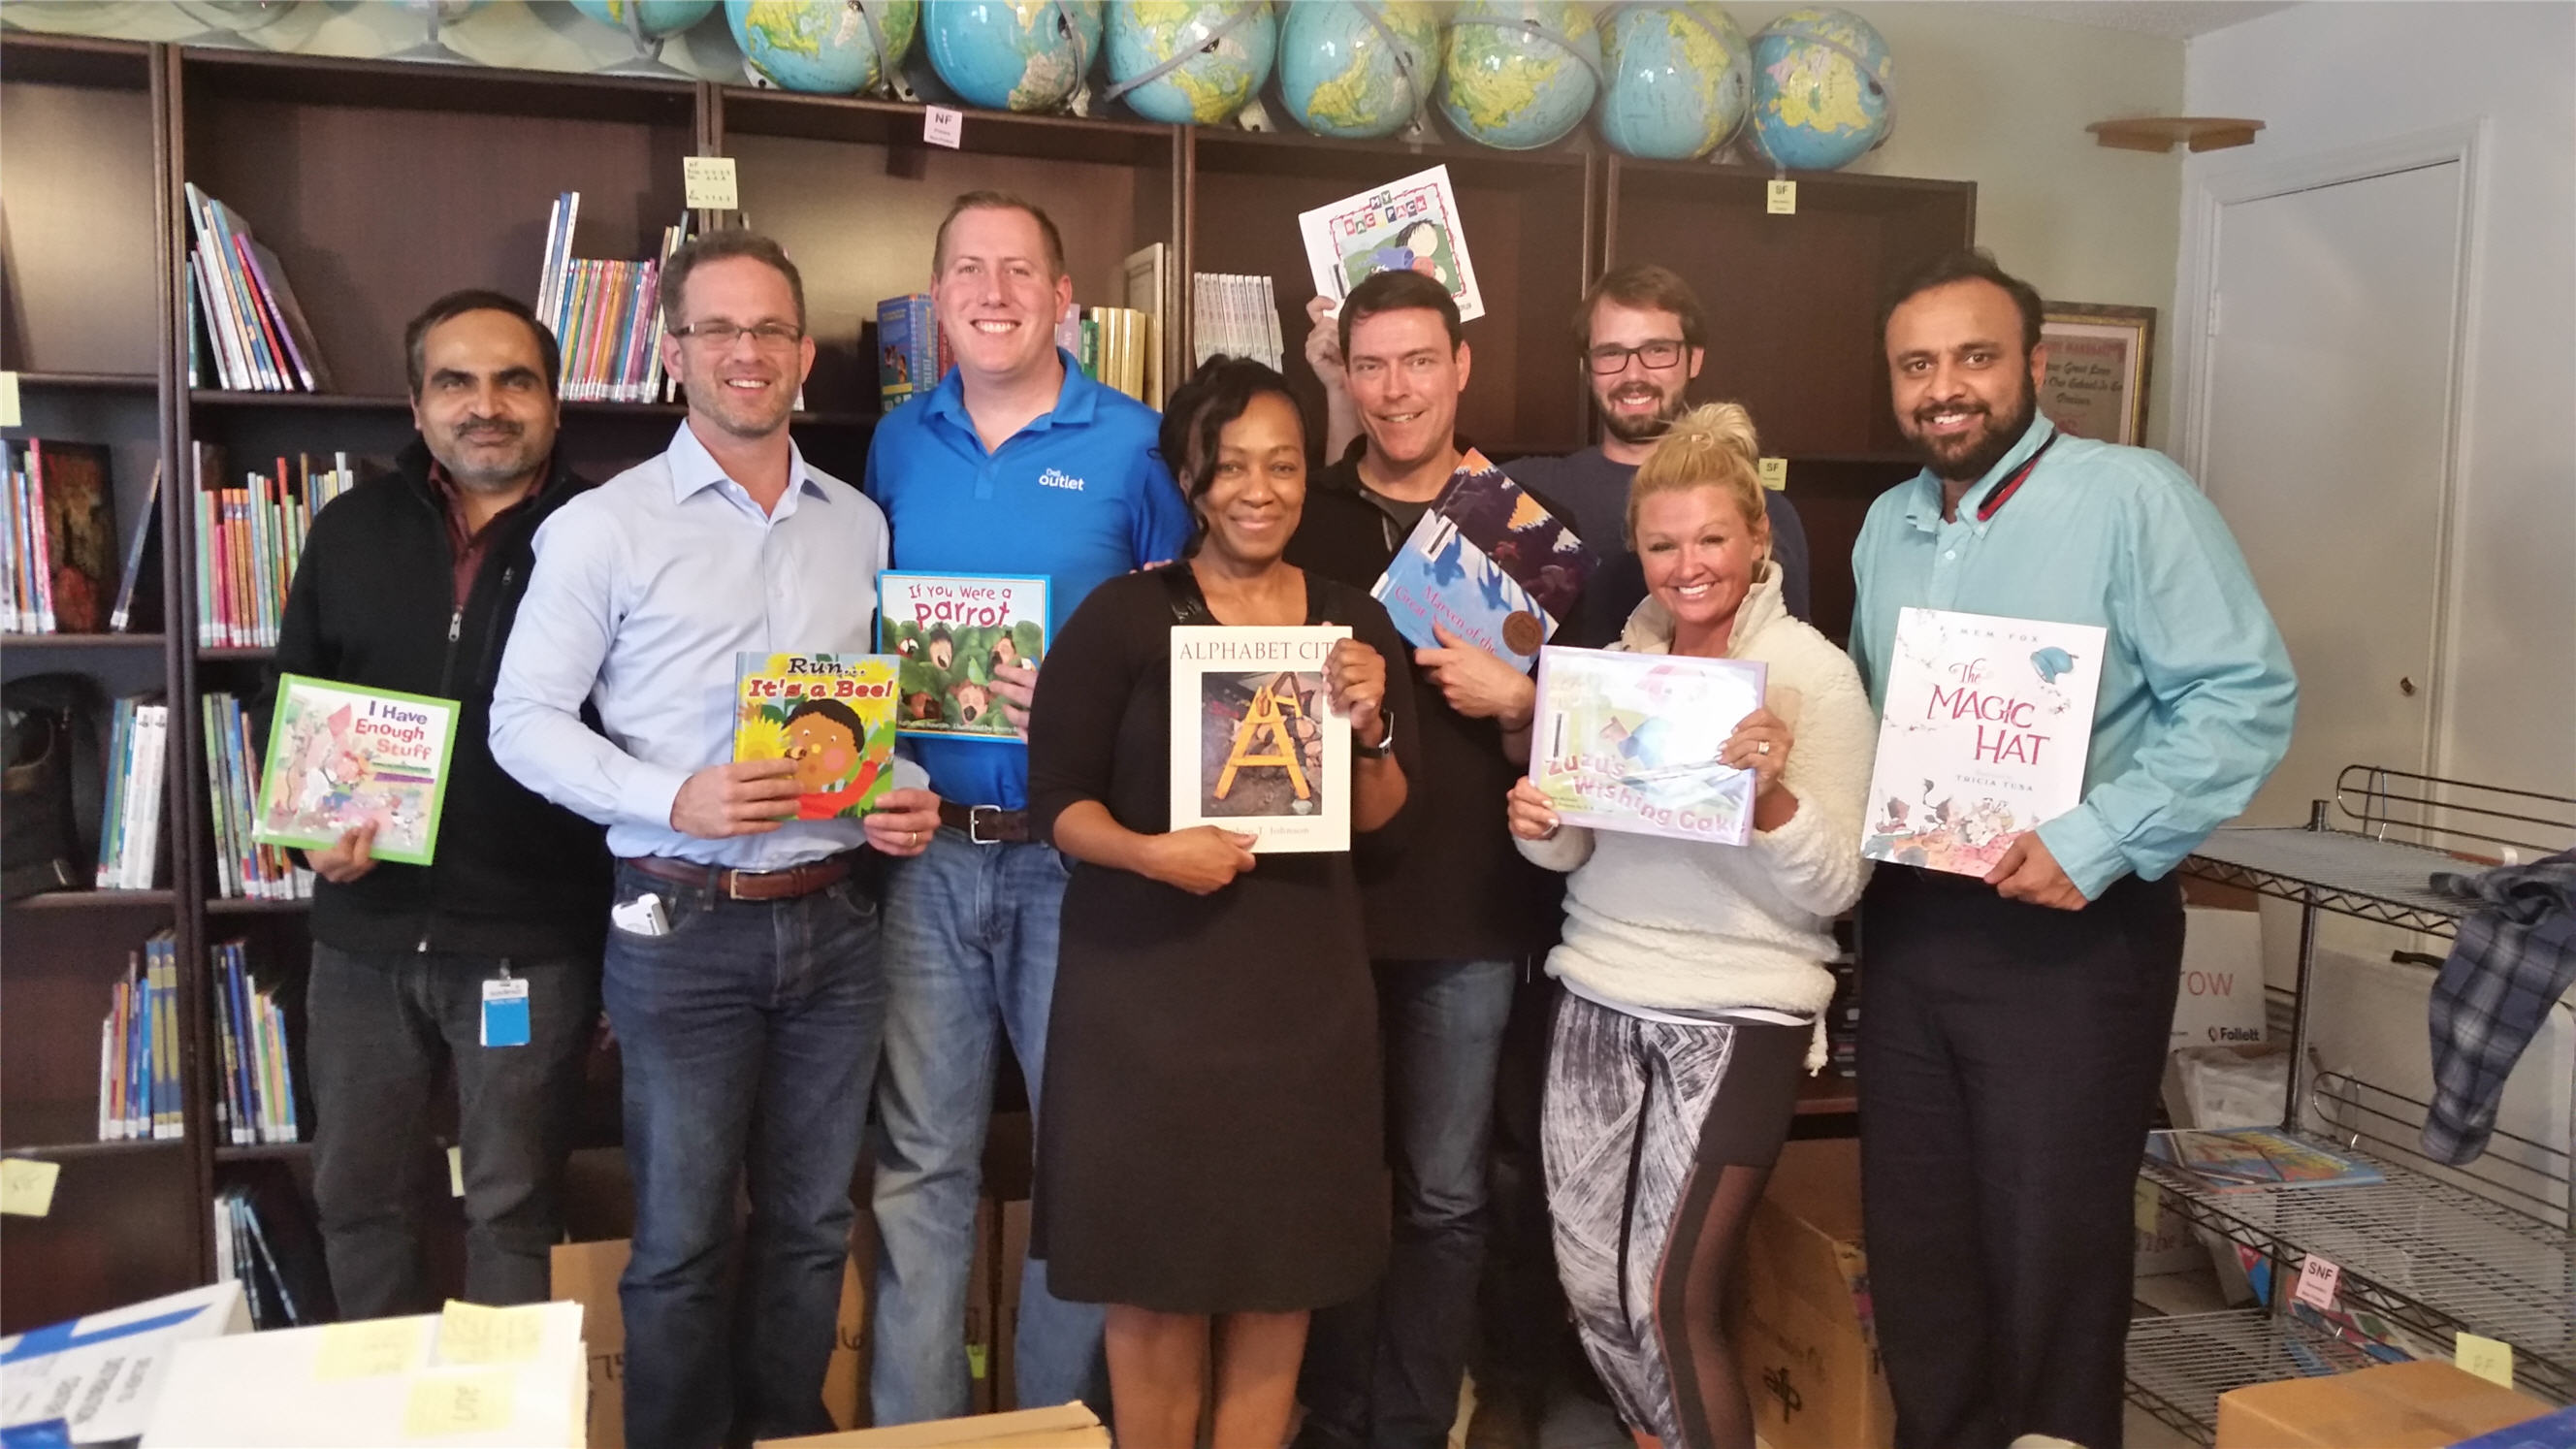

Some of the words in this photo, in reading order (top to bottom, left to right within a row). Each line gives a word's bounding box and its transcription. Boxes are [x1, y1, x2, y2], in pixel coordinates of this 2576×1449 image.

[935, 113, 953, 125] NF
[1775, 184, 1789, 195] SF
[1368, 190, 1393, 210] MY
[1765, 463, 1780, 472] SF
[1038, 474, 1084, 492] outlet
[909, 583, 921, 598] If
[959, 585, 996, 601] Were
[1001, 588, 1013, 599] a
[1465, 628, 1483, 640] of
[1179, 642, 1292, 660] ALPHABET
[1299, 641, 1334, 660] CIT
[1948, 658, 1986, 683] The
[749, 679, 801, 696] It's
[810, 687, 826, 697] a
[369, 700, 376, 716] I
[382, 704, 428, 724] Have
[1926, 683, 2036, 728] MAGIC
[355, 718, 425, 743] Enough
[376, 738, 433, 760] Stuff
[1975, 724, 2050, 765] HAT
[1573, 776, 1673, 825] Wishing
[1678, 811, 1745, 835] Cak
[2219, 1027, 2260, 1042] Follett
[2308, 1262, 2334, 1280] SNF
